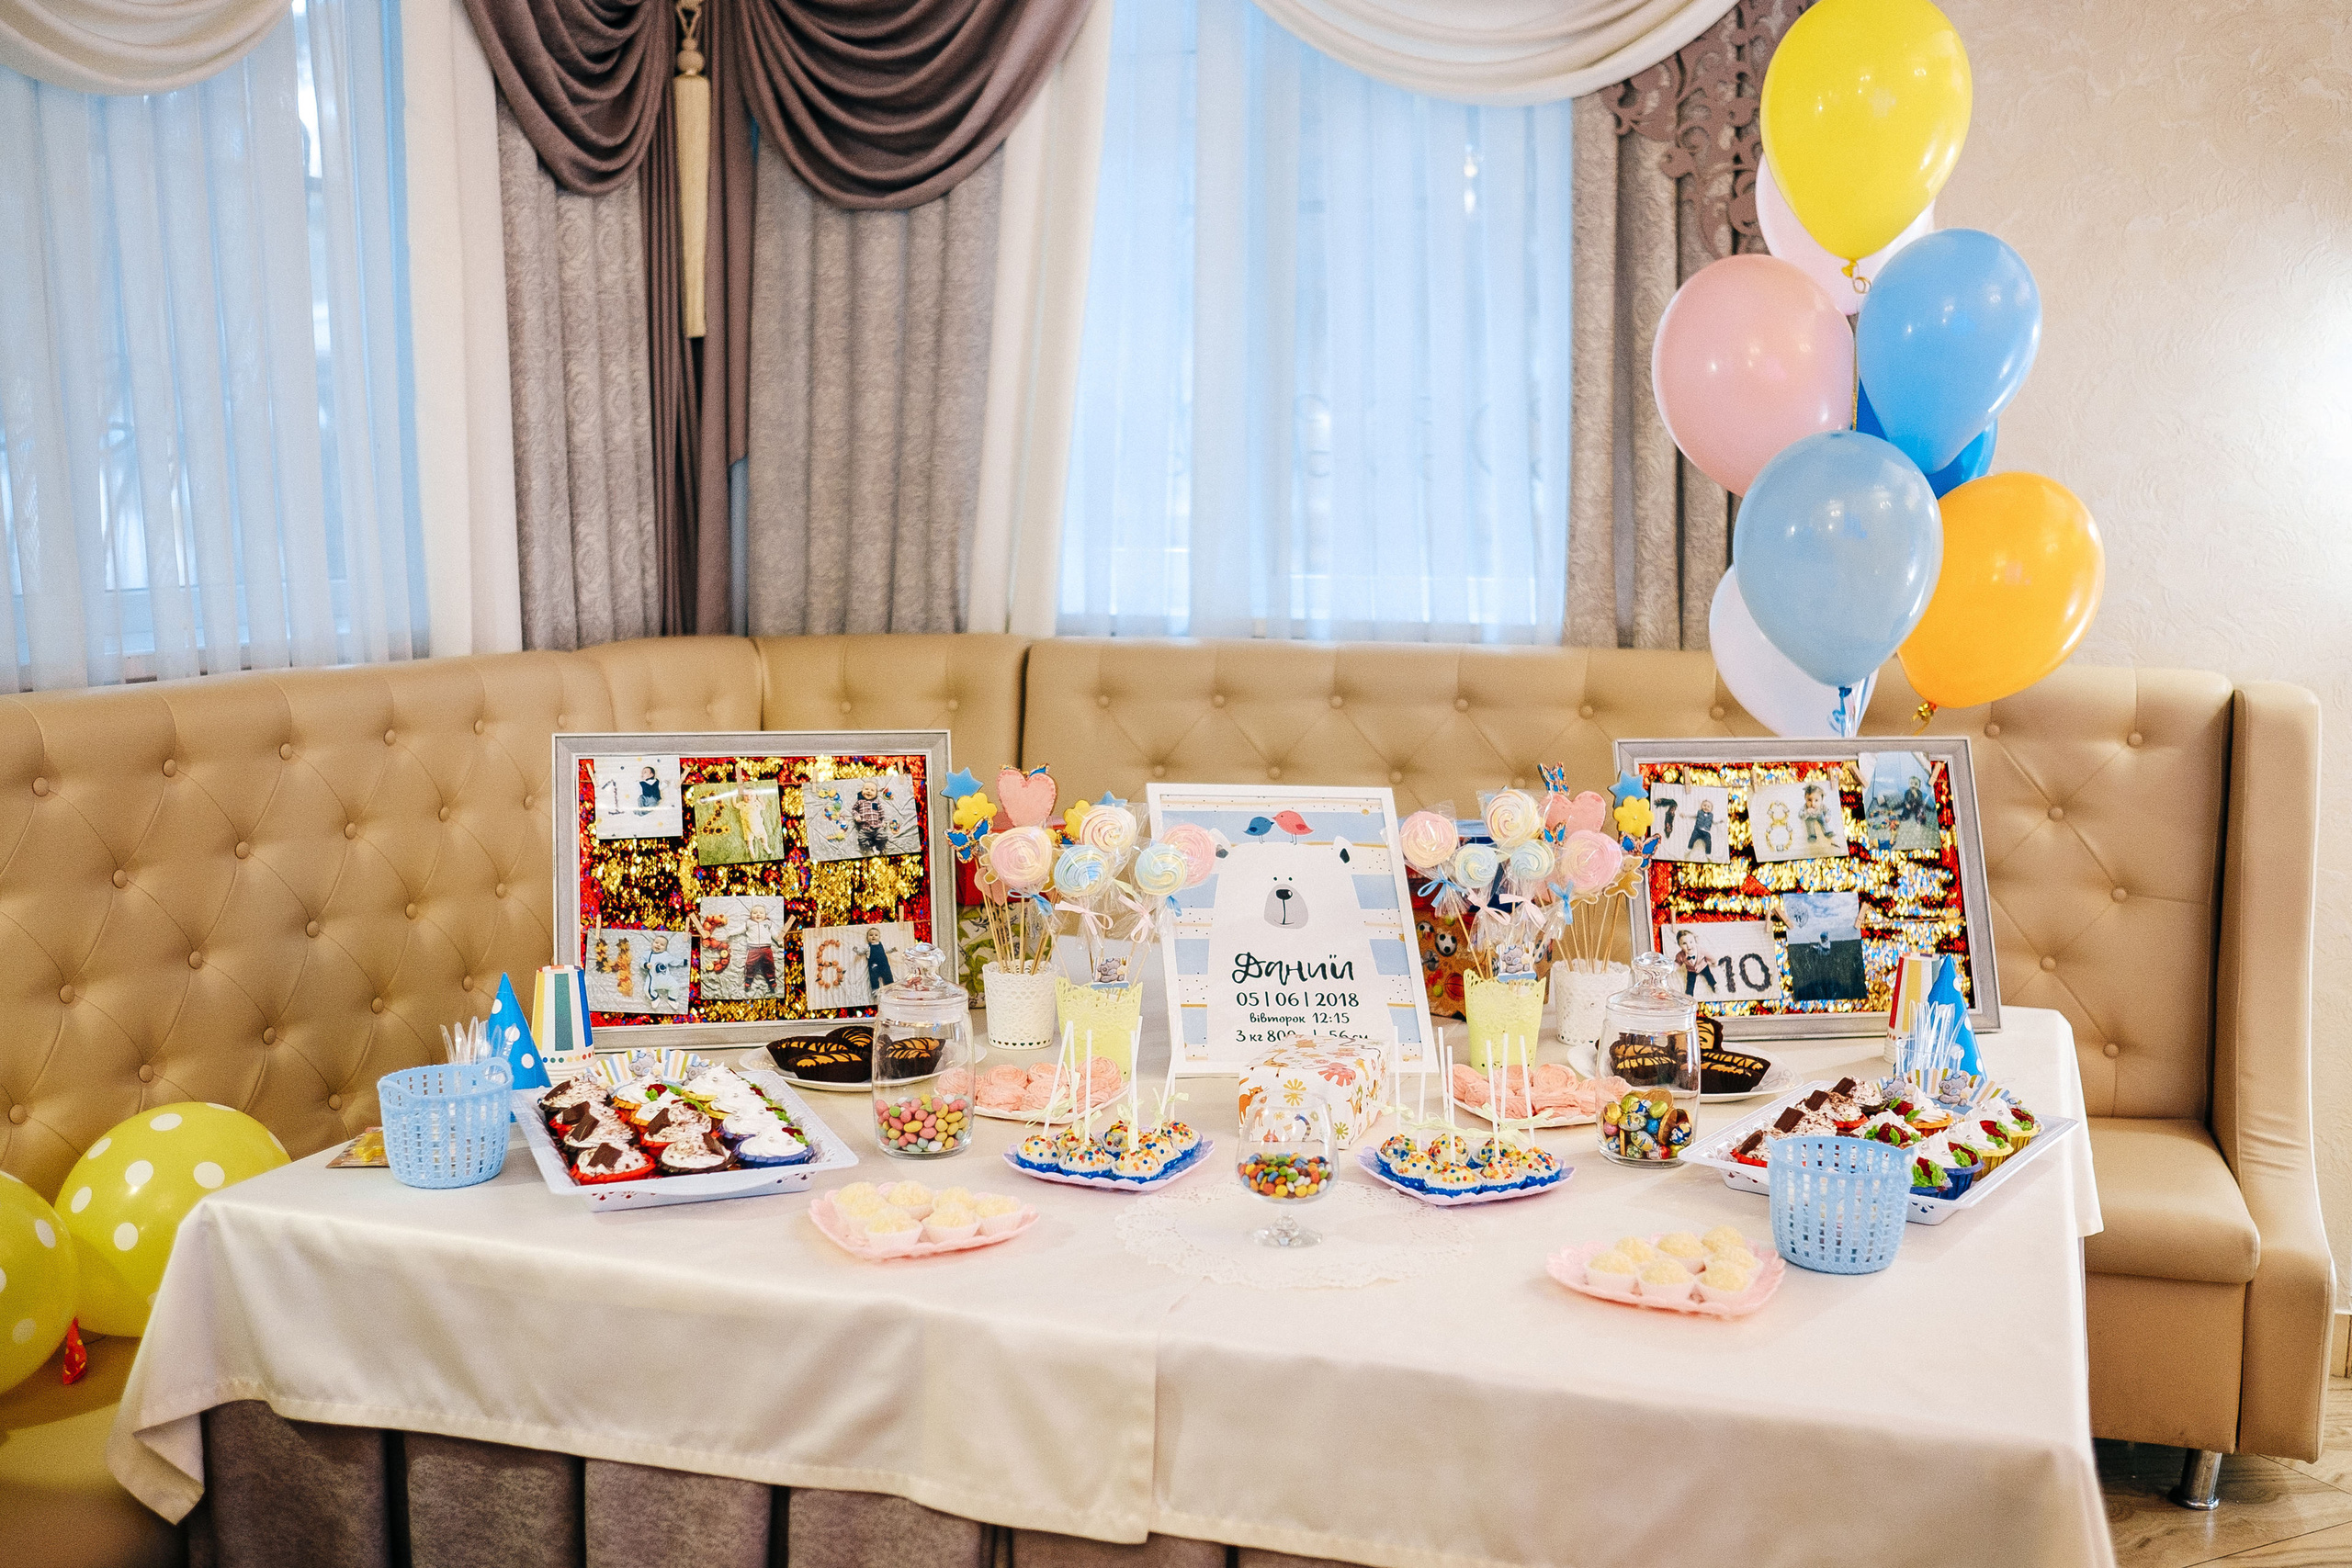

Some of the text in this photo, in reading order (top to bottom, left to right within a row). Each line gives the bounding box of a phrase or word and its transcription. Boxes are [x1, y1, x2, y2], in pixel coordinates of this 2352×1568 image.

[1654, 797, 1678, 839] 7
[1765, 801, 1793, 852] 8
[702, 914, 731, 974] 5
[815, 939, 846, 989] 6
[595, 937, 634, 997] 4
[1717, 953, 1773, 993] 10
[1236, 992, 1260, 1007] 05
[1275, 992, 1299, 1007] 06
[1315, 992, 1360, 1007] 2018
[1250, 1012, 1350, 1026] вівторок 12:15
[1236, 1030, 1246, 1042] 3
[1250, 1033, 1263, 1042] кг
